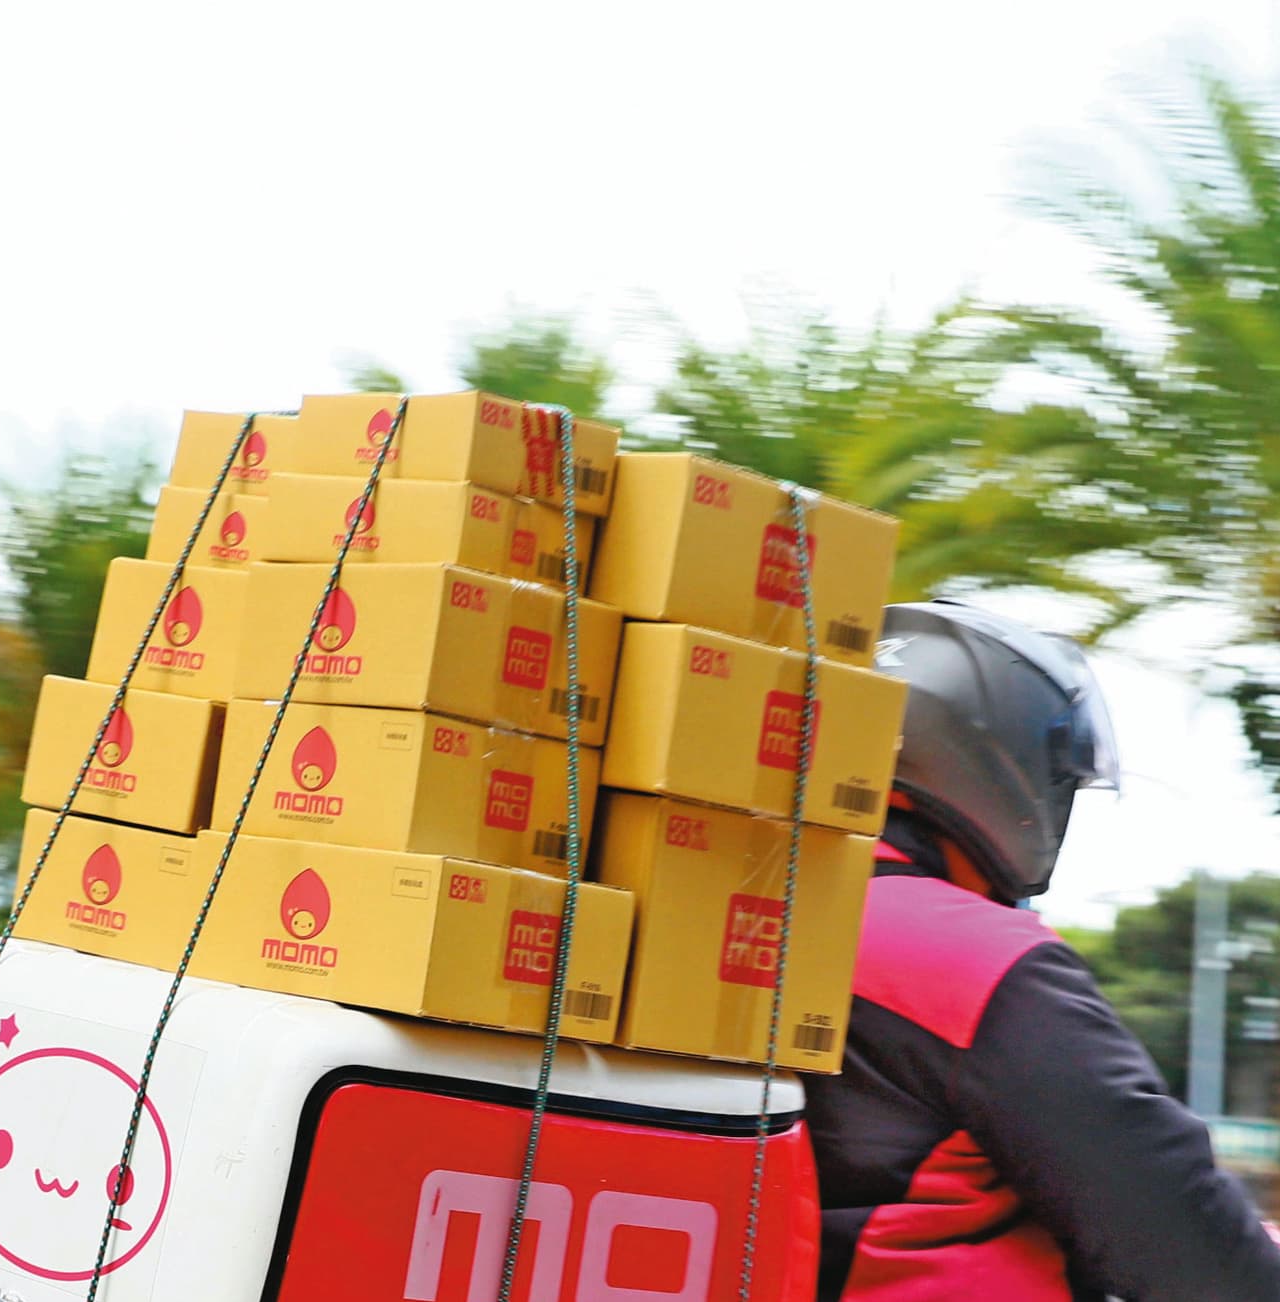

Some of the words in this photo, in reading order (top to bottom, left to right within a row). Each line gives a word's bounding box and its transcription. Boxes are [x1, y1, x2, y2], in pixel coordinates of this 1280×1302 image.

[144, 646, 205, 670] momo
[274, 791, 343, 816] momo
[65, 901, 127, 931] momo
[513, 924, 556, 948] mo
[261, 938, 339, 968] momo
[509, 948, 553, 973] mo
